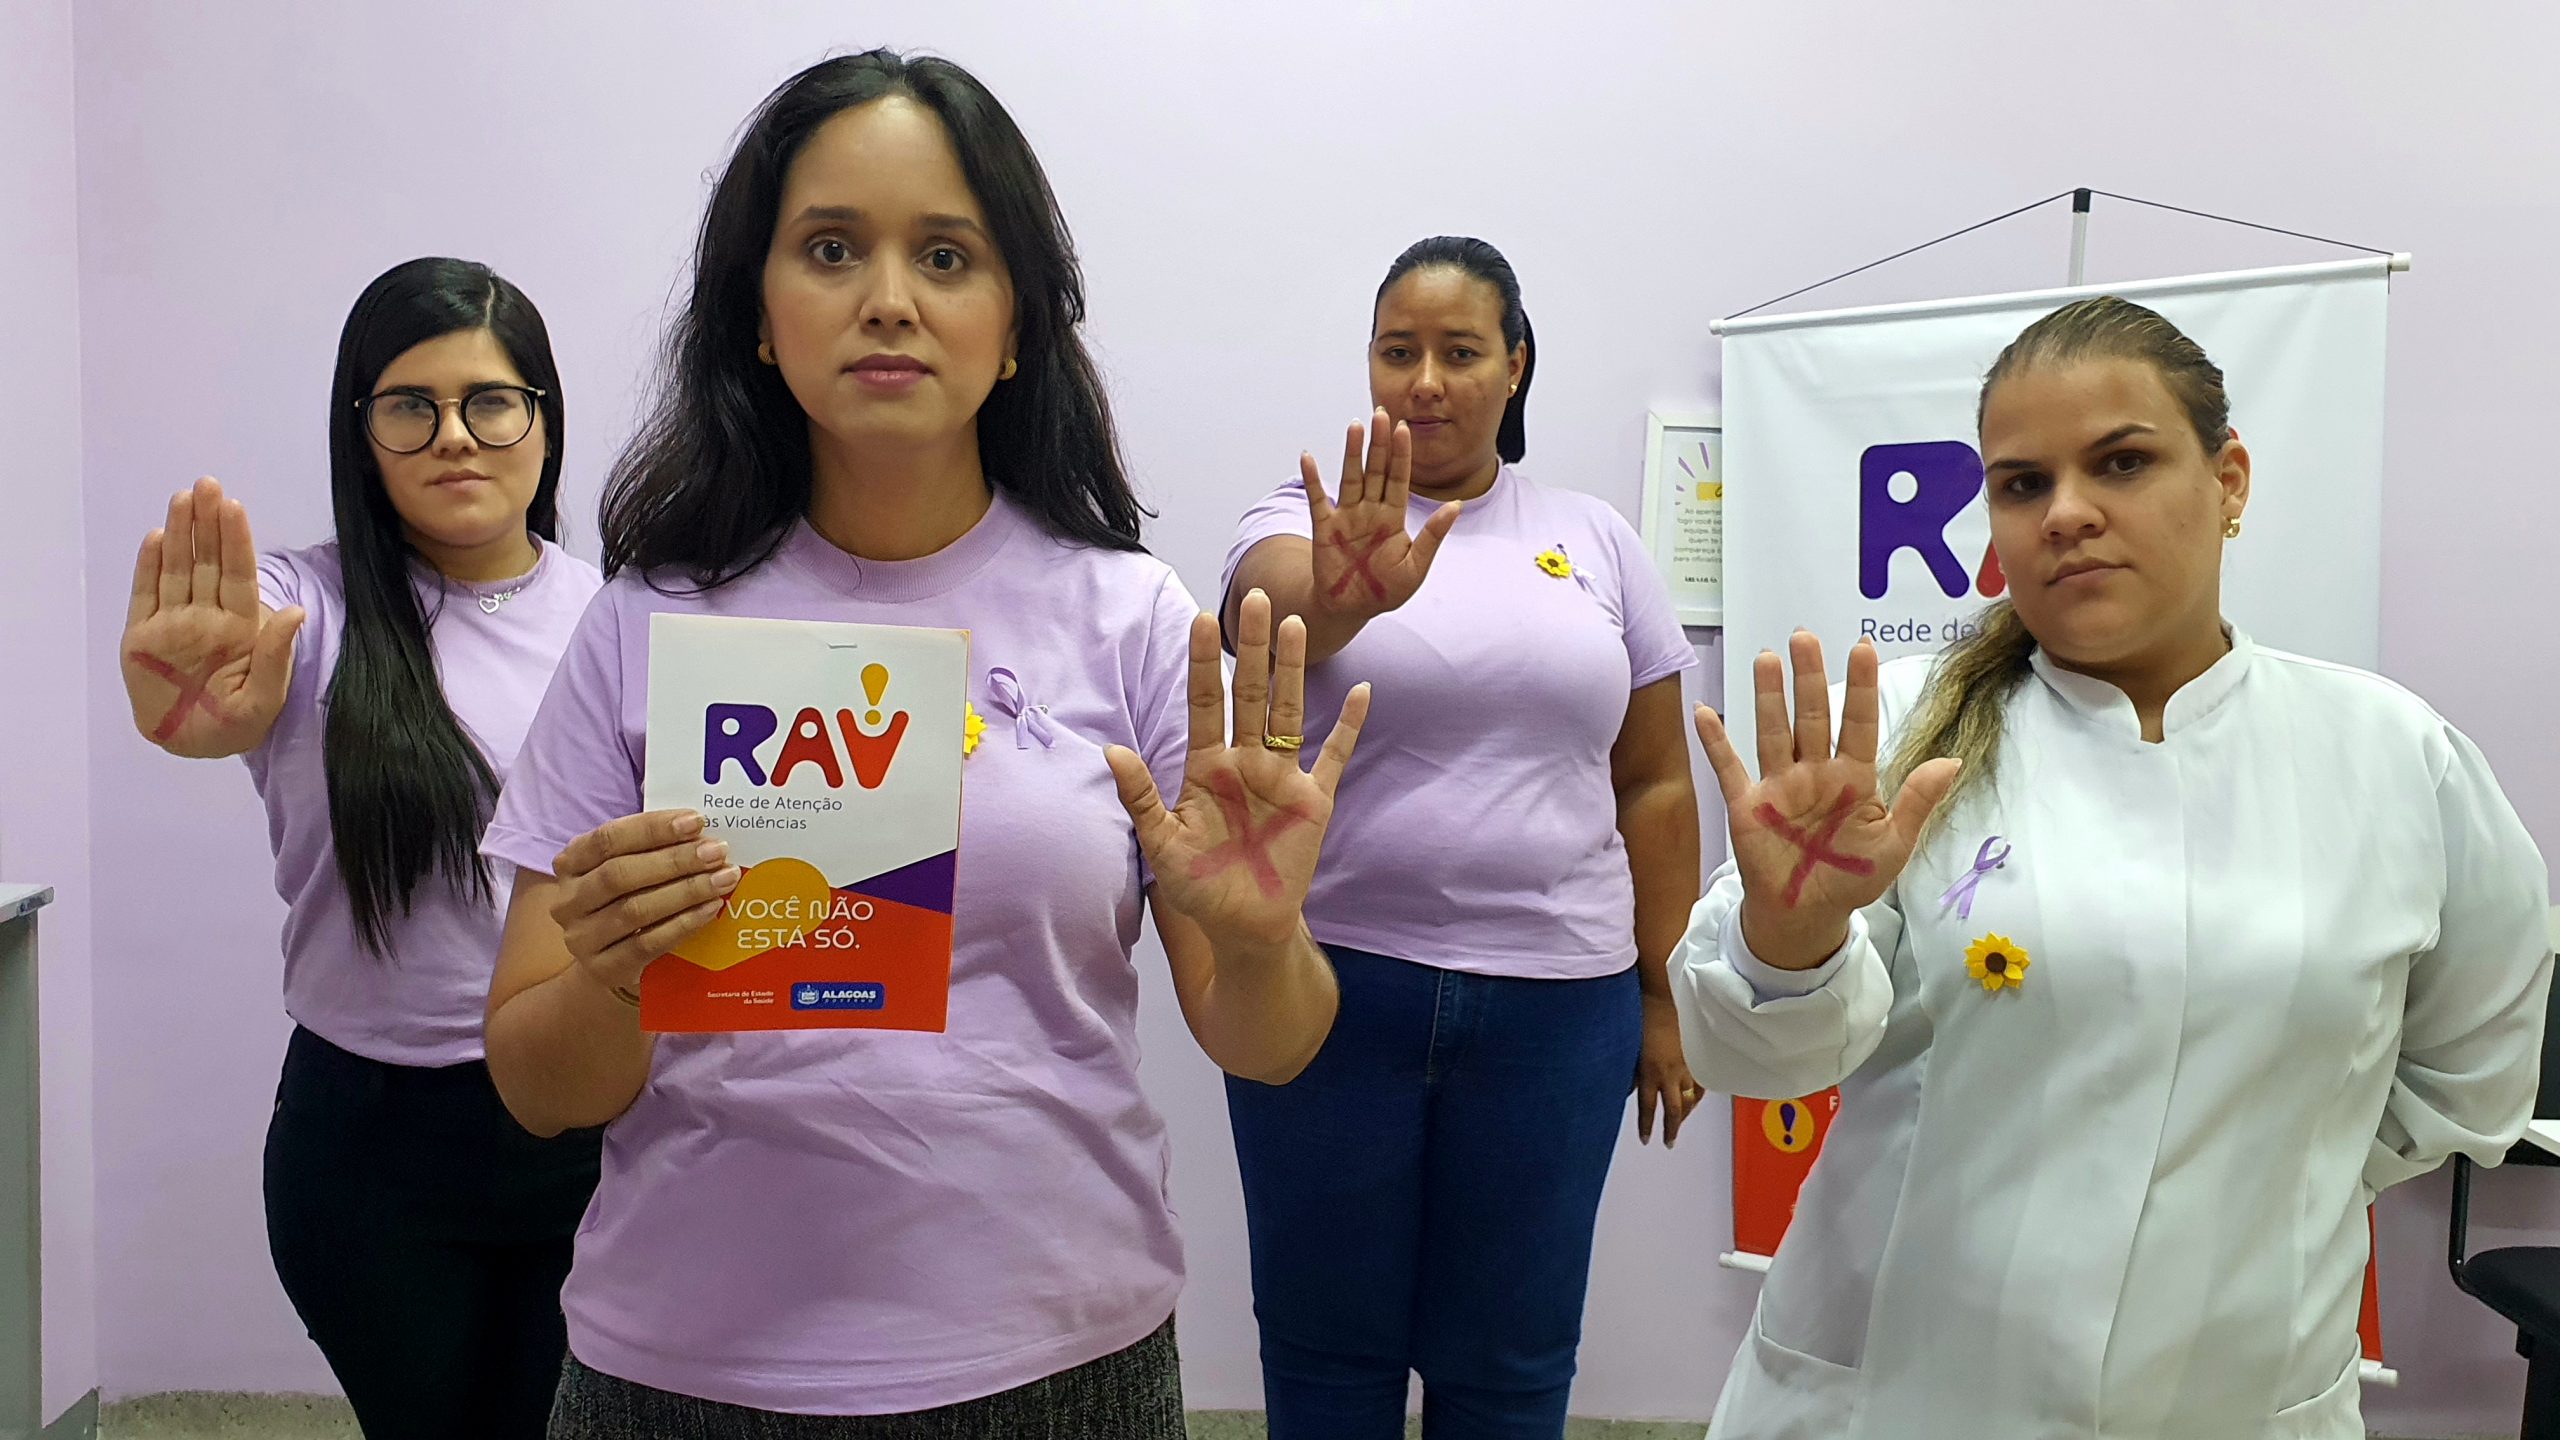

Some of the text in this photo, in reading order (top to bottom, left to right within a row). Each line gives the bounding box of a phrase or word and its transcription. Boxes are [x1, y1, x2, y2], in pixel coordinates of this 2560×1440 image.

[1861, 618, 1931, 642] Rede
[704, 794, 843, 813] Rede de Atenção
[725, 815, 807, 830] Violências
[726, 895, 874, 921] VOCÊ NÃO
[737, 925, 861, 950] ESTÁ SÓ.
[822, 990, 877, 999] ALAGOAS
